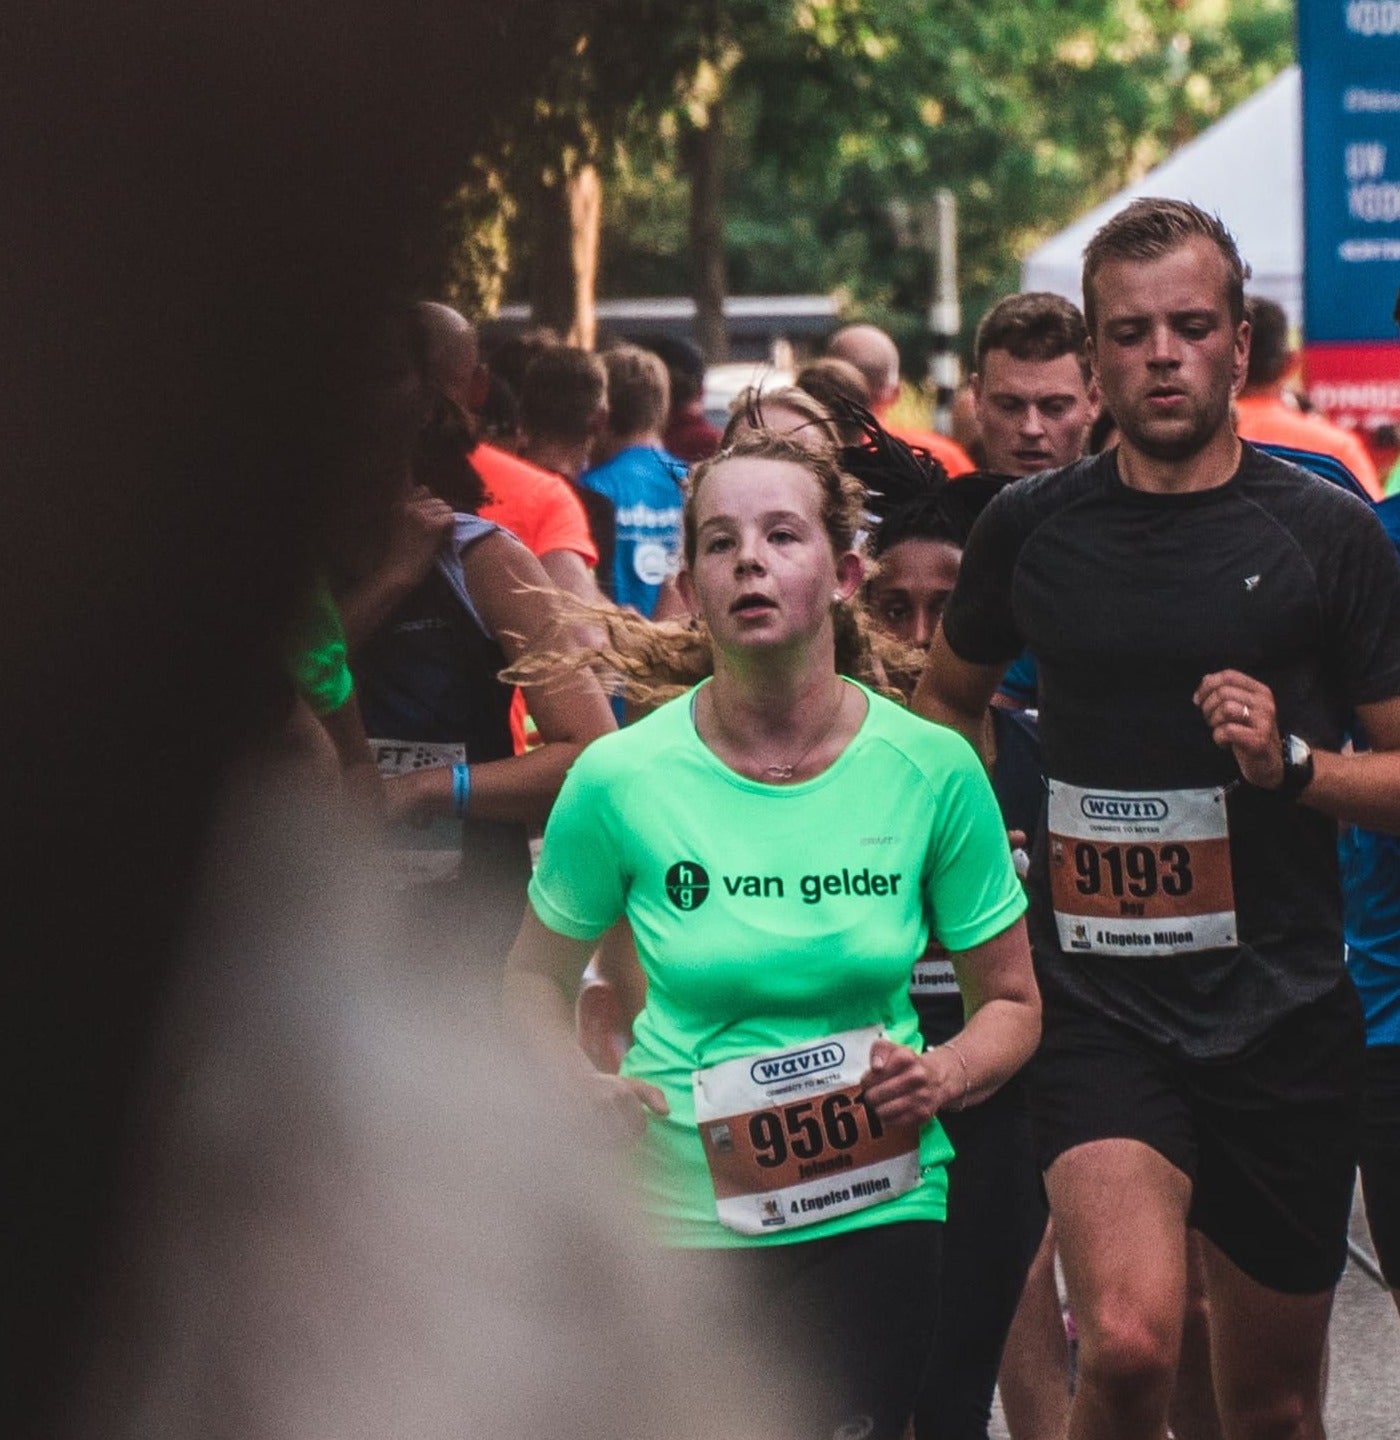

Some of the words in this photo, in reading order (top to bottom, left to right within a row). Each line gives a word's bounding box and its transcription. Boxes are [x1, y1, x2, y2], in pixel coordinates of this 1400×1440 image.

[1088, 800, 1159, 817] wavin
[723, 875, 784, 898] van
[800, 868, 902, 904] gelder
[1074, 843, 1194, 897] 9193
[1096, 931, 1104, 944] 4
[1105, 931, 1151, 947] Engelse
[1153, 931, 1194, 946] Mijlen
[760, 1049, 837, 1079] wavin
[749, 1090, 884, 1168] 9561
[790, 1200, 799, 1214] 4
[801, 1189, 851, 1213] Engelse
[851, 1177, 891, 1199] Mijlen
